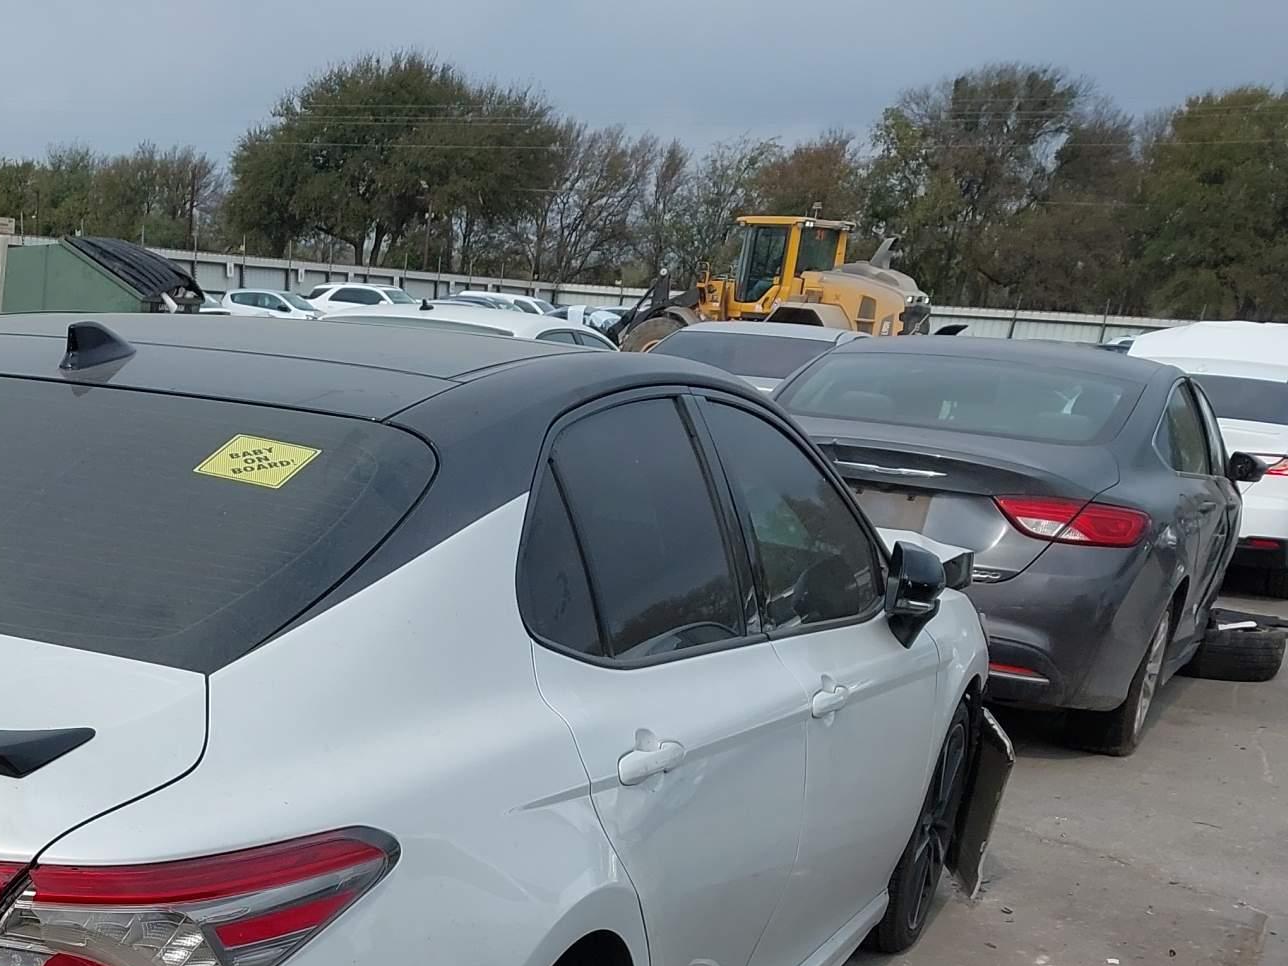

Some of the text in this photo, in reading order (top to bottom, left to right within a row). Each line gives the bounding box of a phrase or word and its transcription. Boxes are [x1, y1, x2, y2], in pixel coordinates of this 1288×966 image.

[229, 447, 274, 459] BABY
[244, 456, 270, 465] ON
[231, 459, 298, 475] BOARD!
